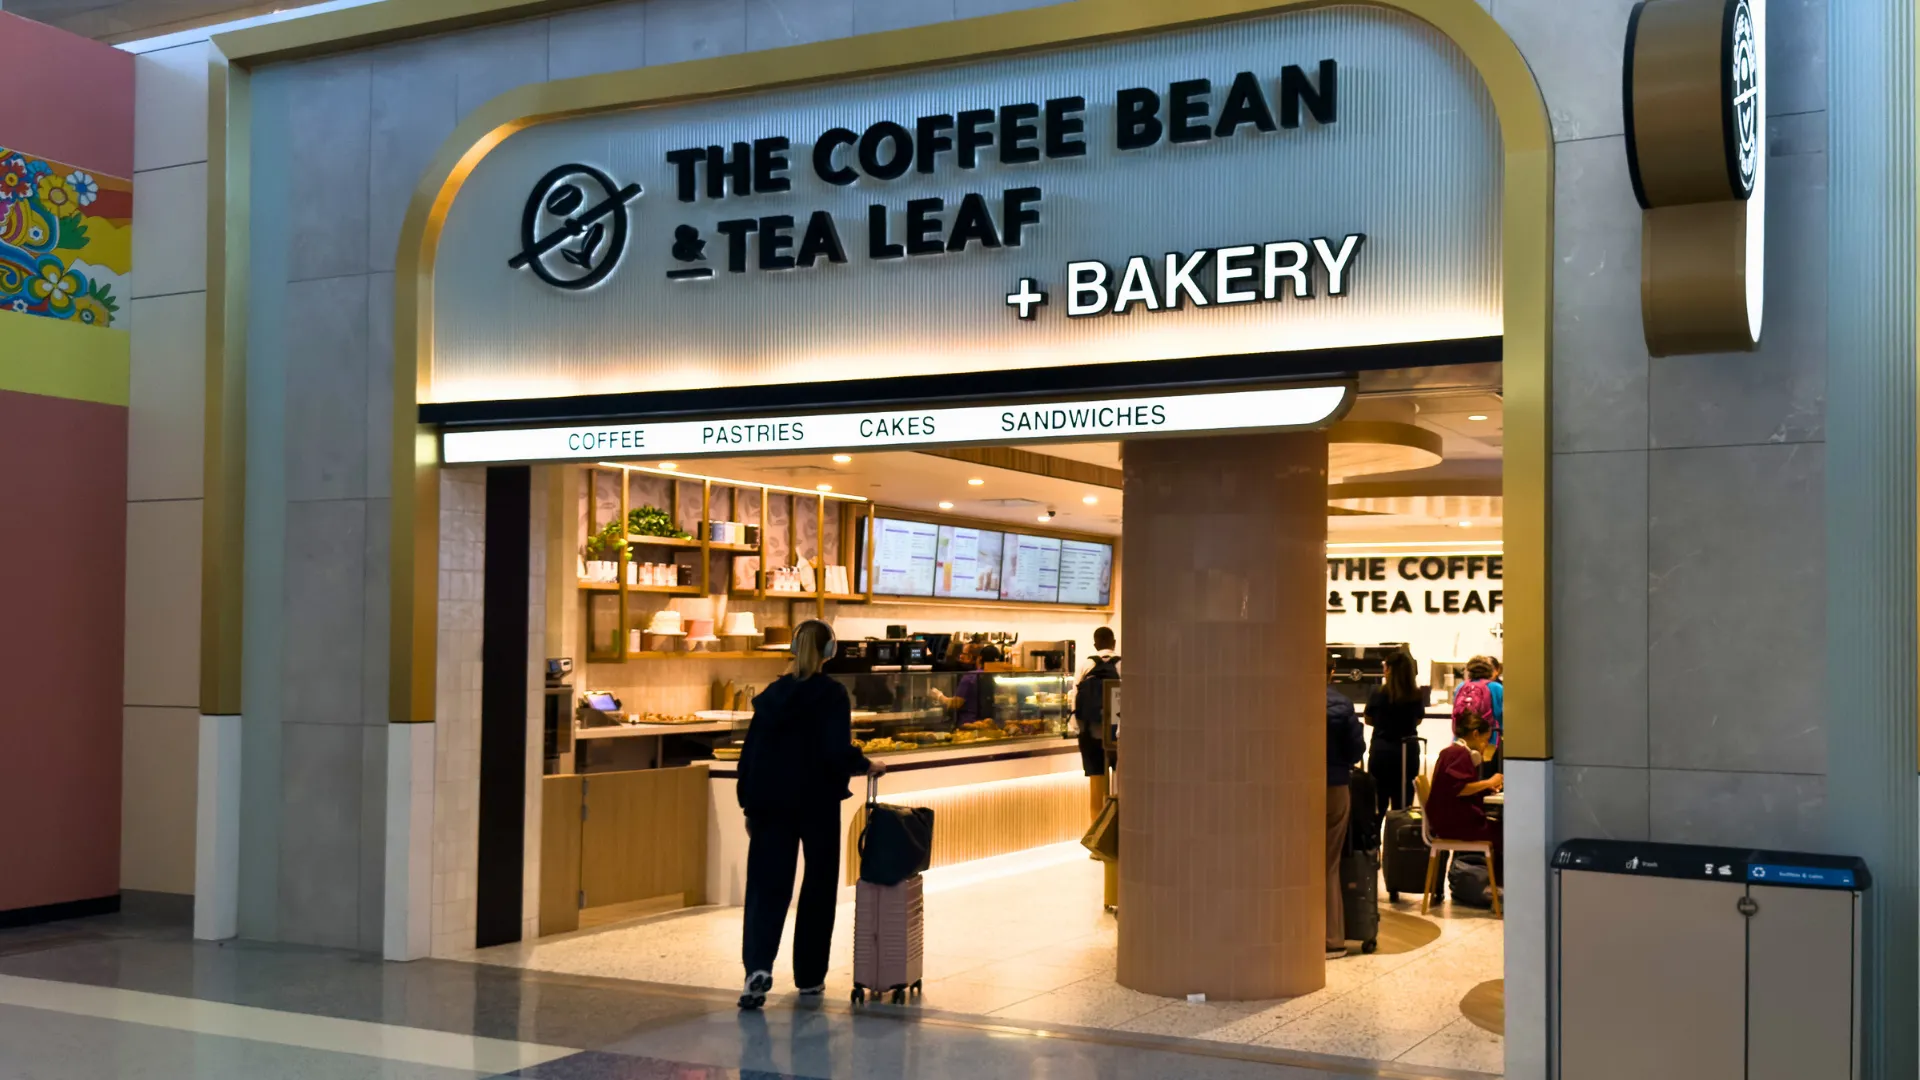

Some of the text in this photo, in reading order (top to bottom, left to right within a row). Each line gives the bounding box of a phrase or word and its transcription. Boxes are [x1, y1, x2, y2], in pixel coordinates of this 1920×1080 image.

[666, 59, 1338, 202] THE COFFEE BEAN
[667, 187, 1042, 279] & TEA LEAF
[1006, 233, 1365, 320] + BAKERY
[568, 404, 1167, 451] COFFEE PASTRIES CAKES SANDWICHES
[1327, 557, 1387, 581] THE
[1327, 590, 1503, 613] & TEA LEAF
